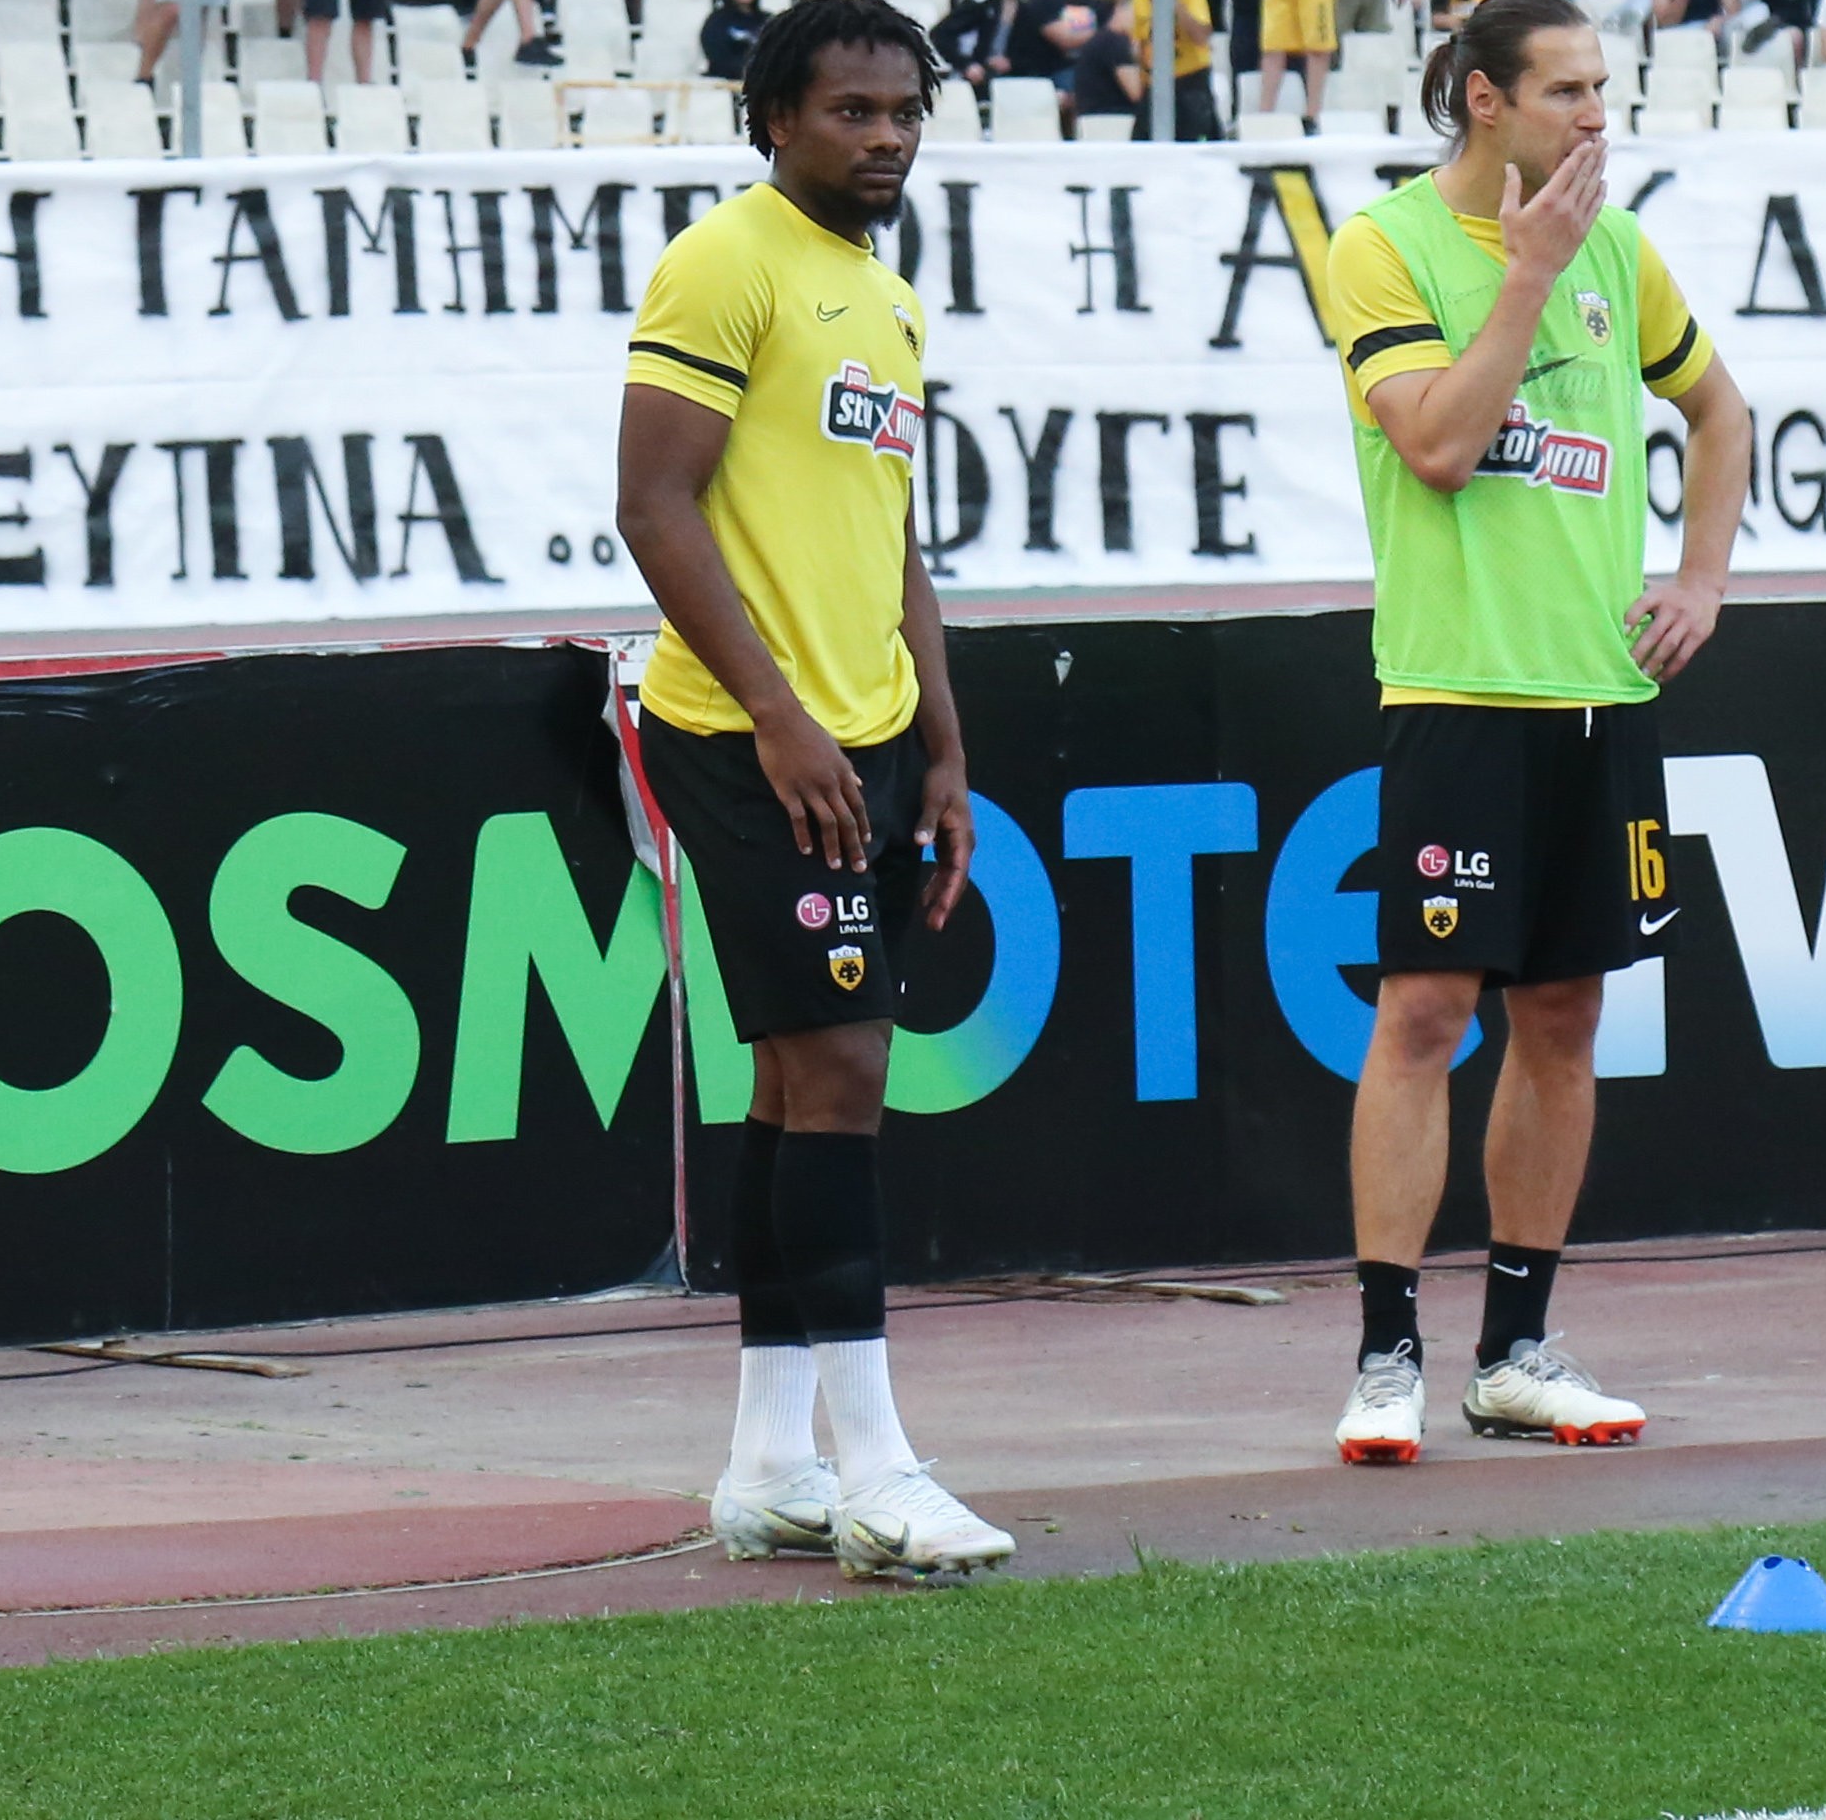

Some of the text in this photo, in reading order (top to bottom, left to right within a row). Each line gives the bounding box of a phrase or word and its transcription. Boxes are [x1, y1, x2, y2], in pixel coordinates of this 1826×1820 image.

[1454, 850, 1490, 877] LG
[1627, 818, 1666, 902] 16
[835, 895, 870, 922] LG
